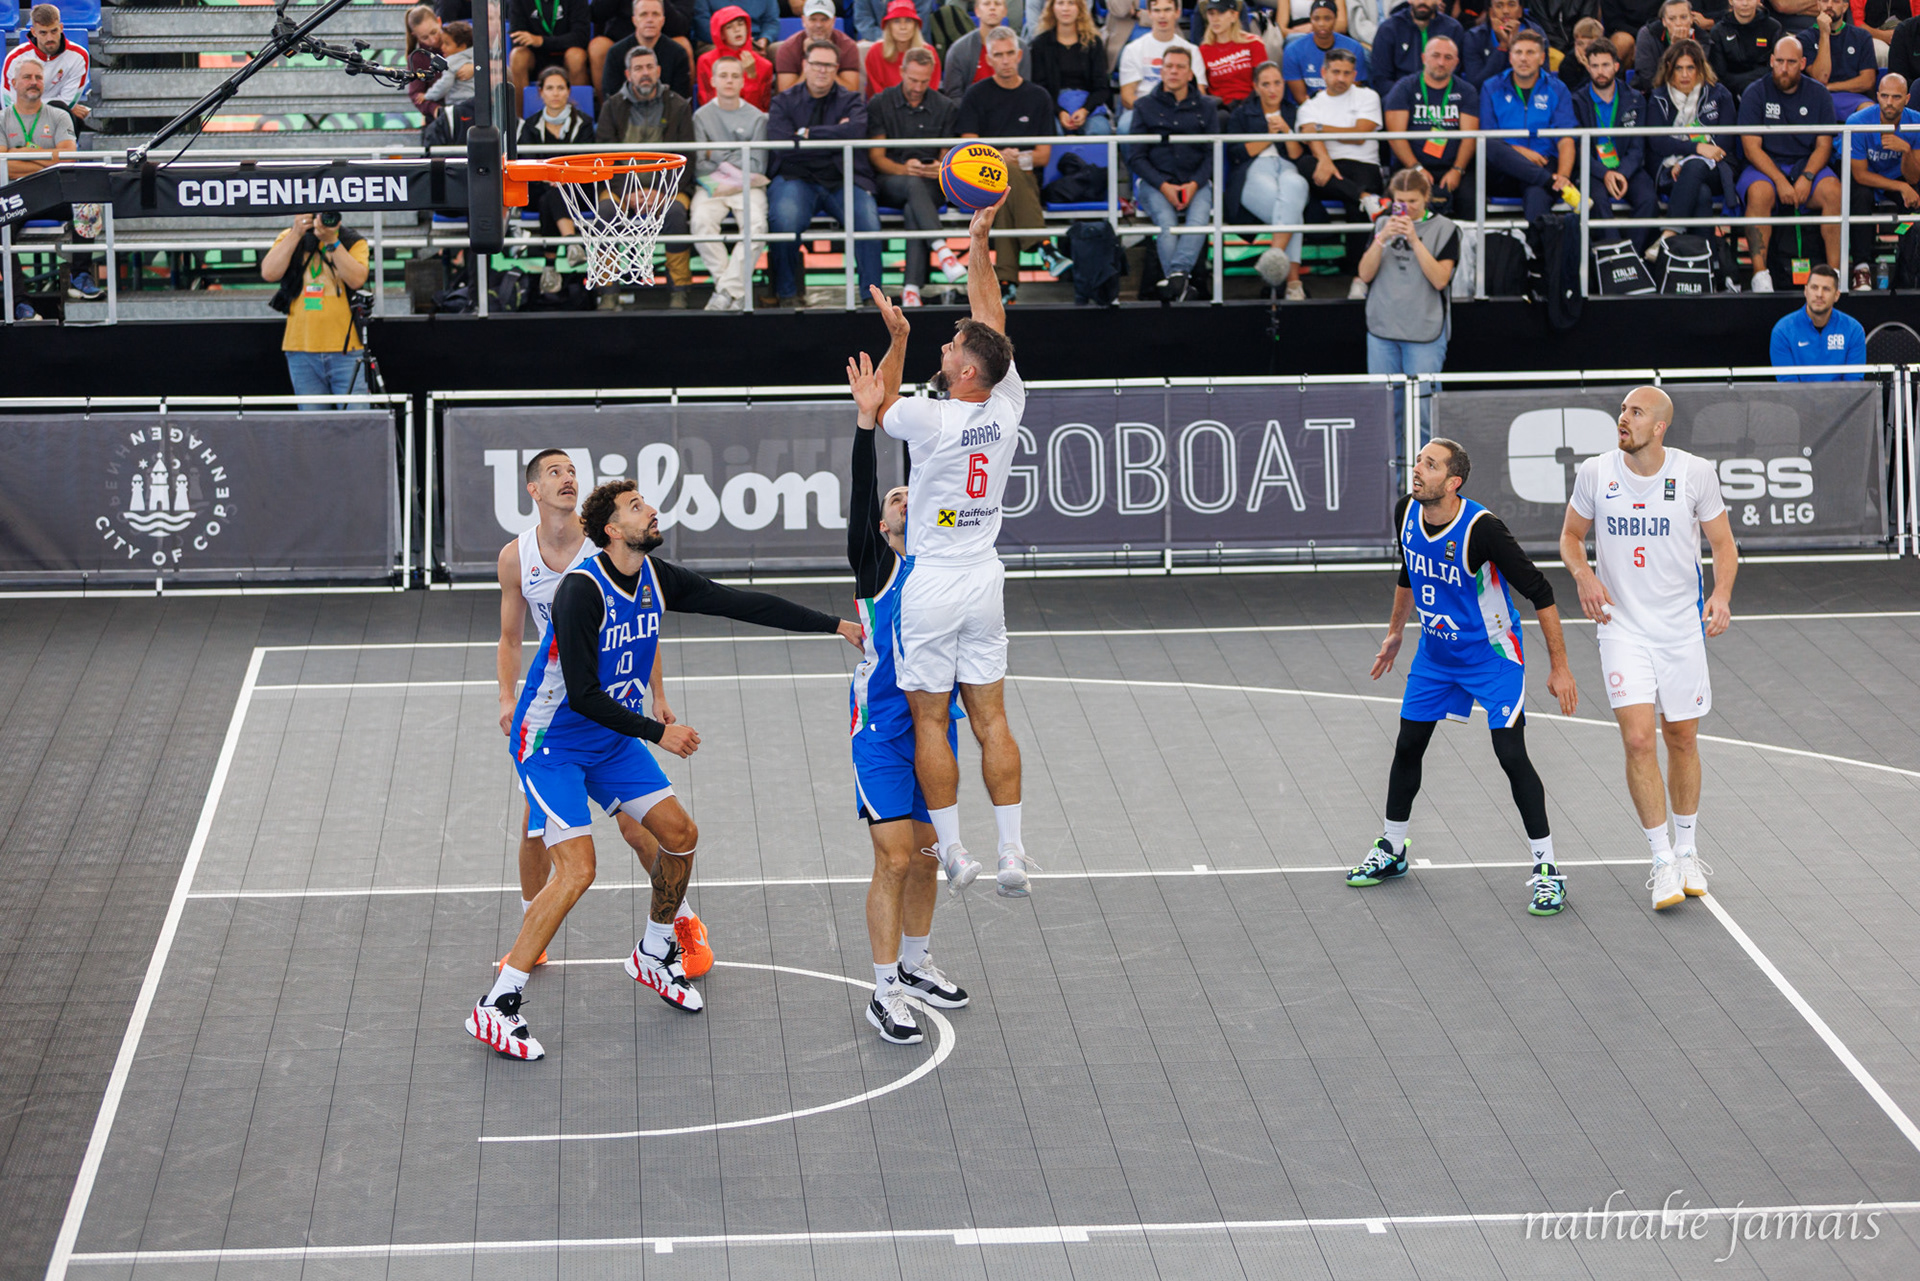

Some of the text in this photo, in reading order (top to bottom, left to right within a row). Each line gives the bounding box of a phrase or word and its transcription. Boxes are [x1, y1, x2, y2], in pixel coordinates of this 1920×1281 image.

[967, 148, 1006, 164] Wilso
[178, 176, 408, 206] COPENHAGEN
[1612, 266, 1638, 280] ITALIA
[1676, 282, 1702, 293] ITALIA
[966, 453, 989, 499] 6
[95, 426, 230, 566] CITY OF COPENHAGEN
[957, 518, 981, 527] Bank
[1770, 503, 1815, 525] LEG
[1607, 516, 1670, 536] SRBIJA
[1634, 547, 1645, 567] 5
[1421, 585, 1436, 606] 8
[602, 612, 660, 652] ITALIA
[1423, 625, 1458, 641] WAYS
[615, 651, 633, 676] 10
